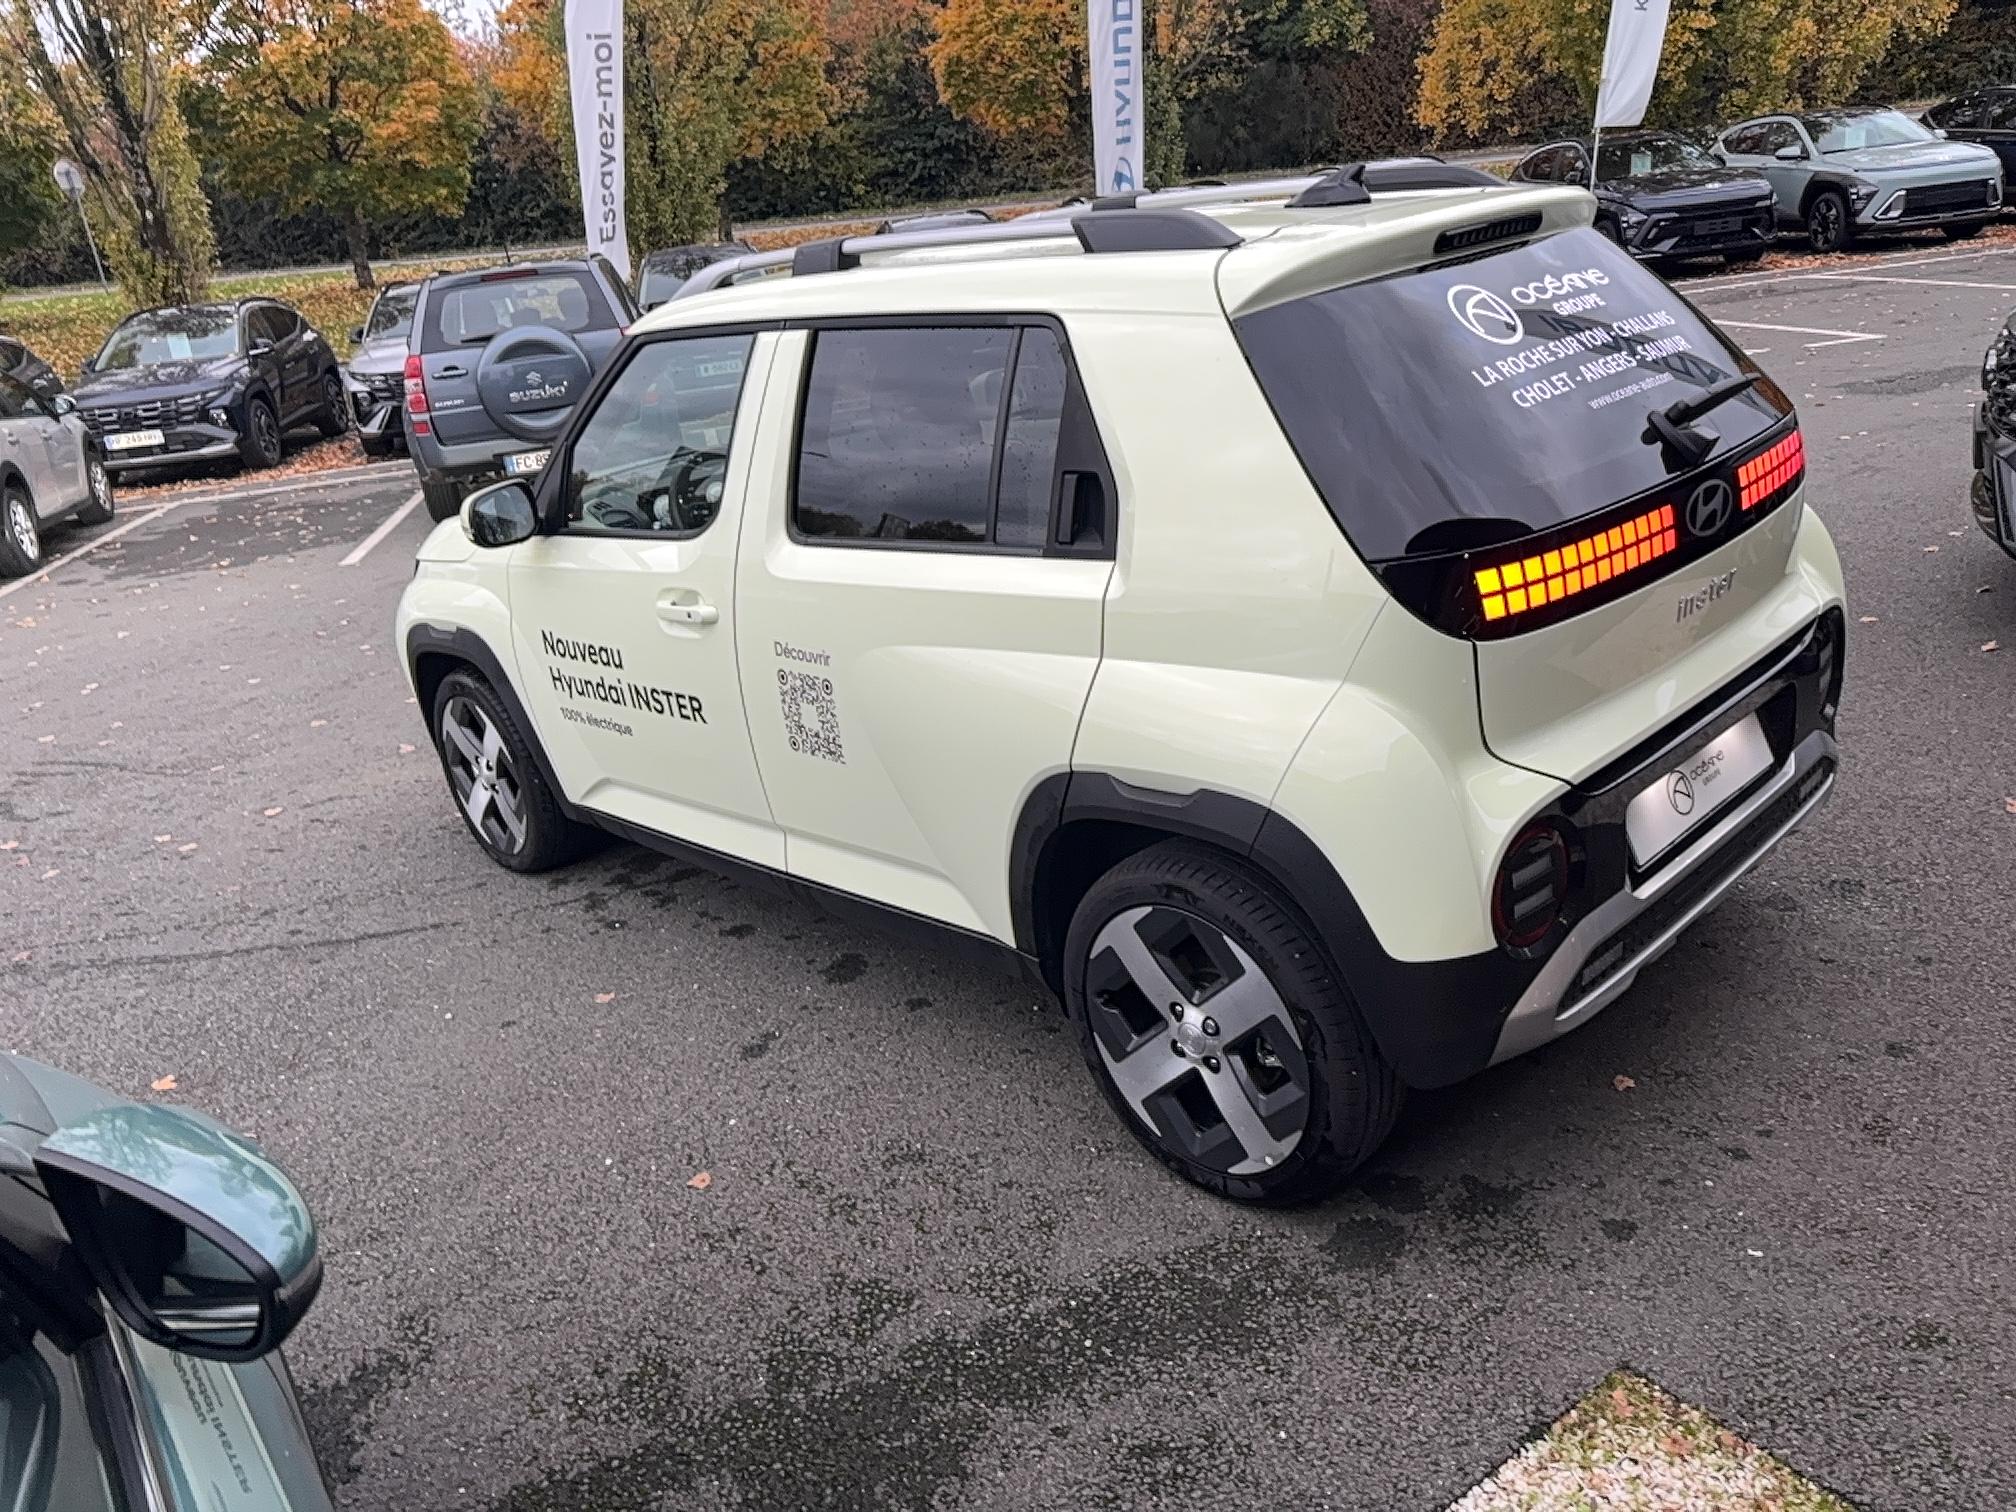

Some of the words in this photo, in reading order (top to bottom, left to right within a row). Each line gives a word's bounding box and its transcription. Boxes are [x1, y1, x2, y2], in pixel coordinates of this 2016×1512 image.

[586, 32, 617, 245] Essayez-moi
[1553, 293, 1607, 316] GROUPE
[1472, 364, 1497, 387] LA
[1495, 343, 1556, 377] ROCHE
[1549, 331, 1586, 362] SUR
[1579, 326, 1613, 351] YON
[1612, 310, 1676, 337] CHALLANS
[1512, 371, 1577, 408] CHOLET
[1579, 351, 1637, 383] ANGERS
[1636, 335, 1692, 361] SAUMUR
[1676, 568, 1737, 623] inster
[541, 629, 624, 670] Nouveau
[774, 641, 831, 666] Découvrir
[549, 665, 627, 707] Hyundai
[627, 682, 708, 724] INSTER
[560, 706, 587, 725] 100%
[585, 711, 633, 737] électrique
